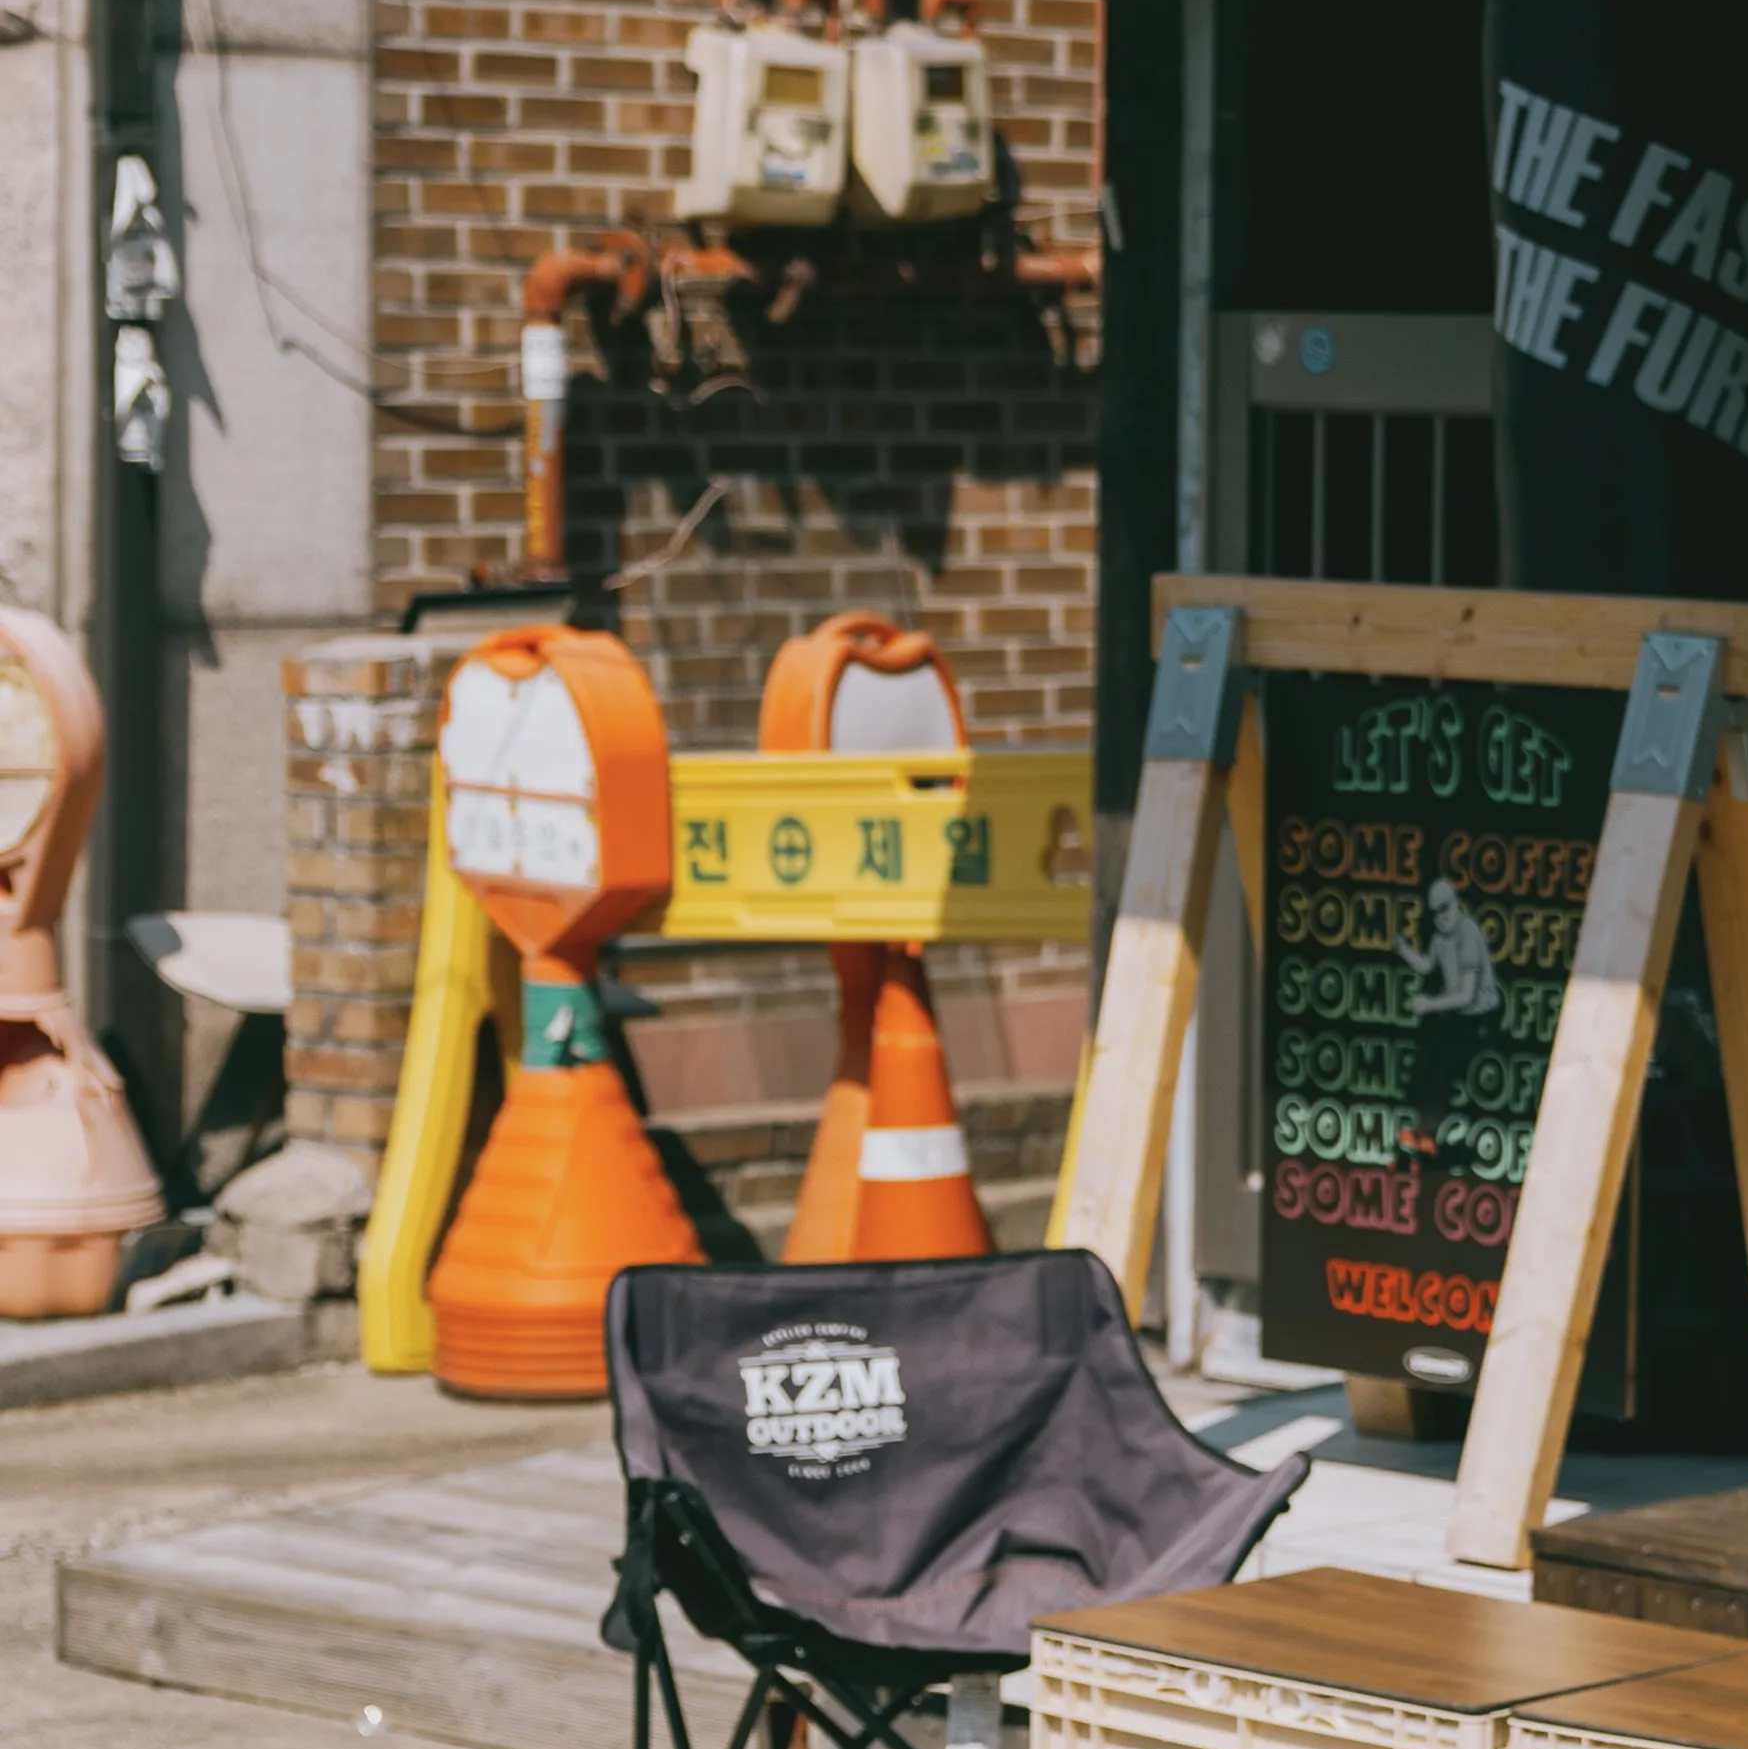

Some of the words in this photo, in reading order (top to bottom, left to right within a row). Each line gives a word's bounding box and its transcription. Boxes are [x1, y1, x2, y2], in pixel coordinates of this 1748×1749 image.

[1493, 77, 1622, 230] THE
[1493, 222, 1602, 371] THE
[1332, 695, 1463, 798] LET'S
[1477, 704, 1573, 808] GET
[1276, 816, 1424, 885] SOME
[1276, 883, 1423, 953] SOME
[1275, 953, 1423, 1029] SOME
[1273, 1158, 1420, 1235] SOME
[740, 1356, 907, 1418] KZM
[746, 1405, 909, 1447] OUTDOOR
